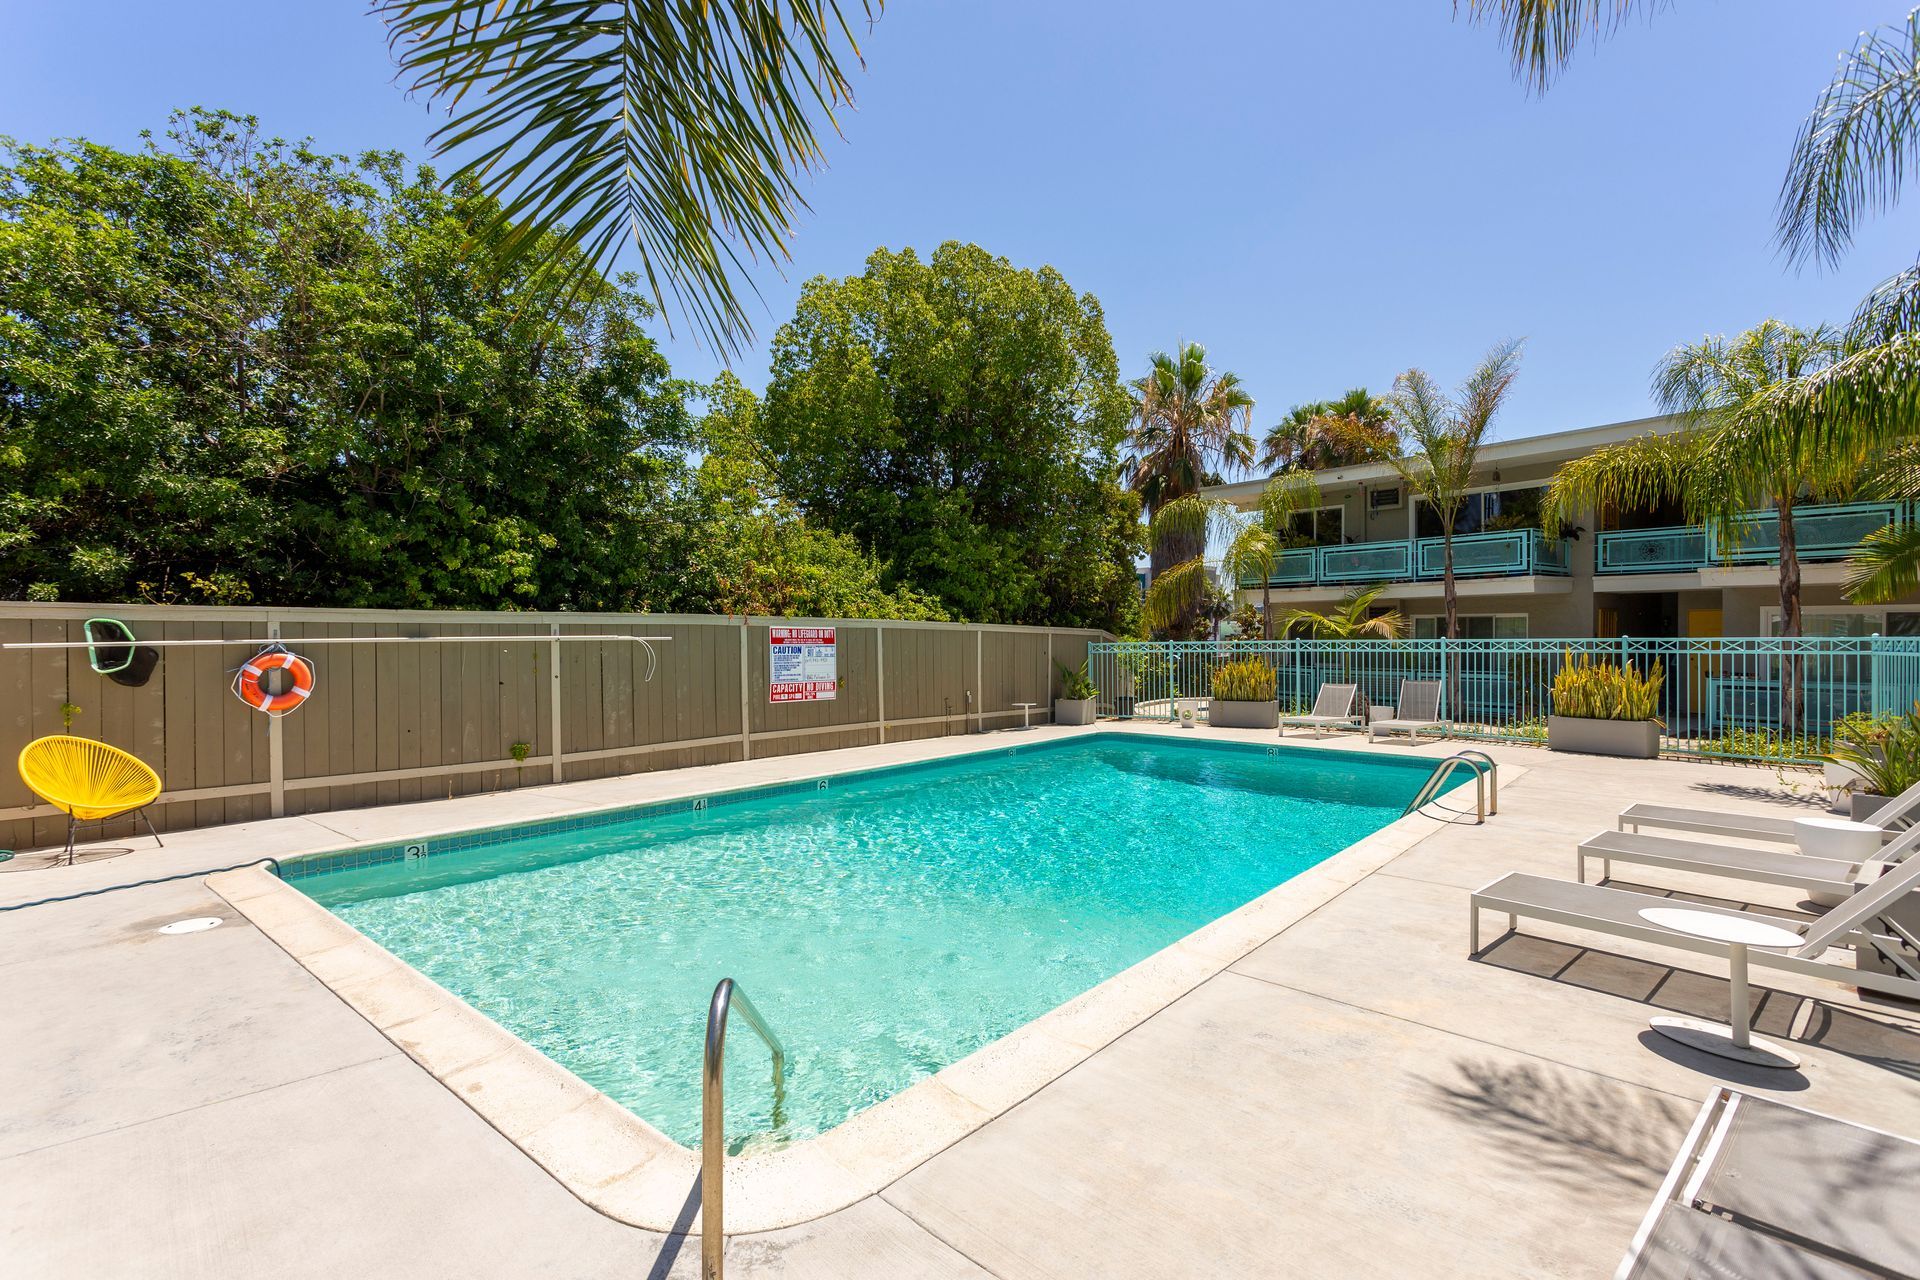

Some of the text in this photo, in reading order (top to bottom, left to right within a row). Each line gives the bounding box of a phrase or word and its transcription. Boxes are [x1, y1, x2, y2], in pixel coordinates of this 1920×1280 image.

[798, 629, 818, 638] LIFEGUARD
[824, 630, 834, 638] DUTY
[772, 646, 802, 655] CAUTION
[772, 684, 803, 693] CAPACITY
[806, 682, 834, 691] NO DIVING
